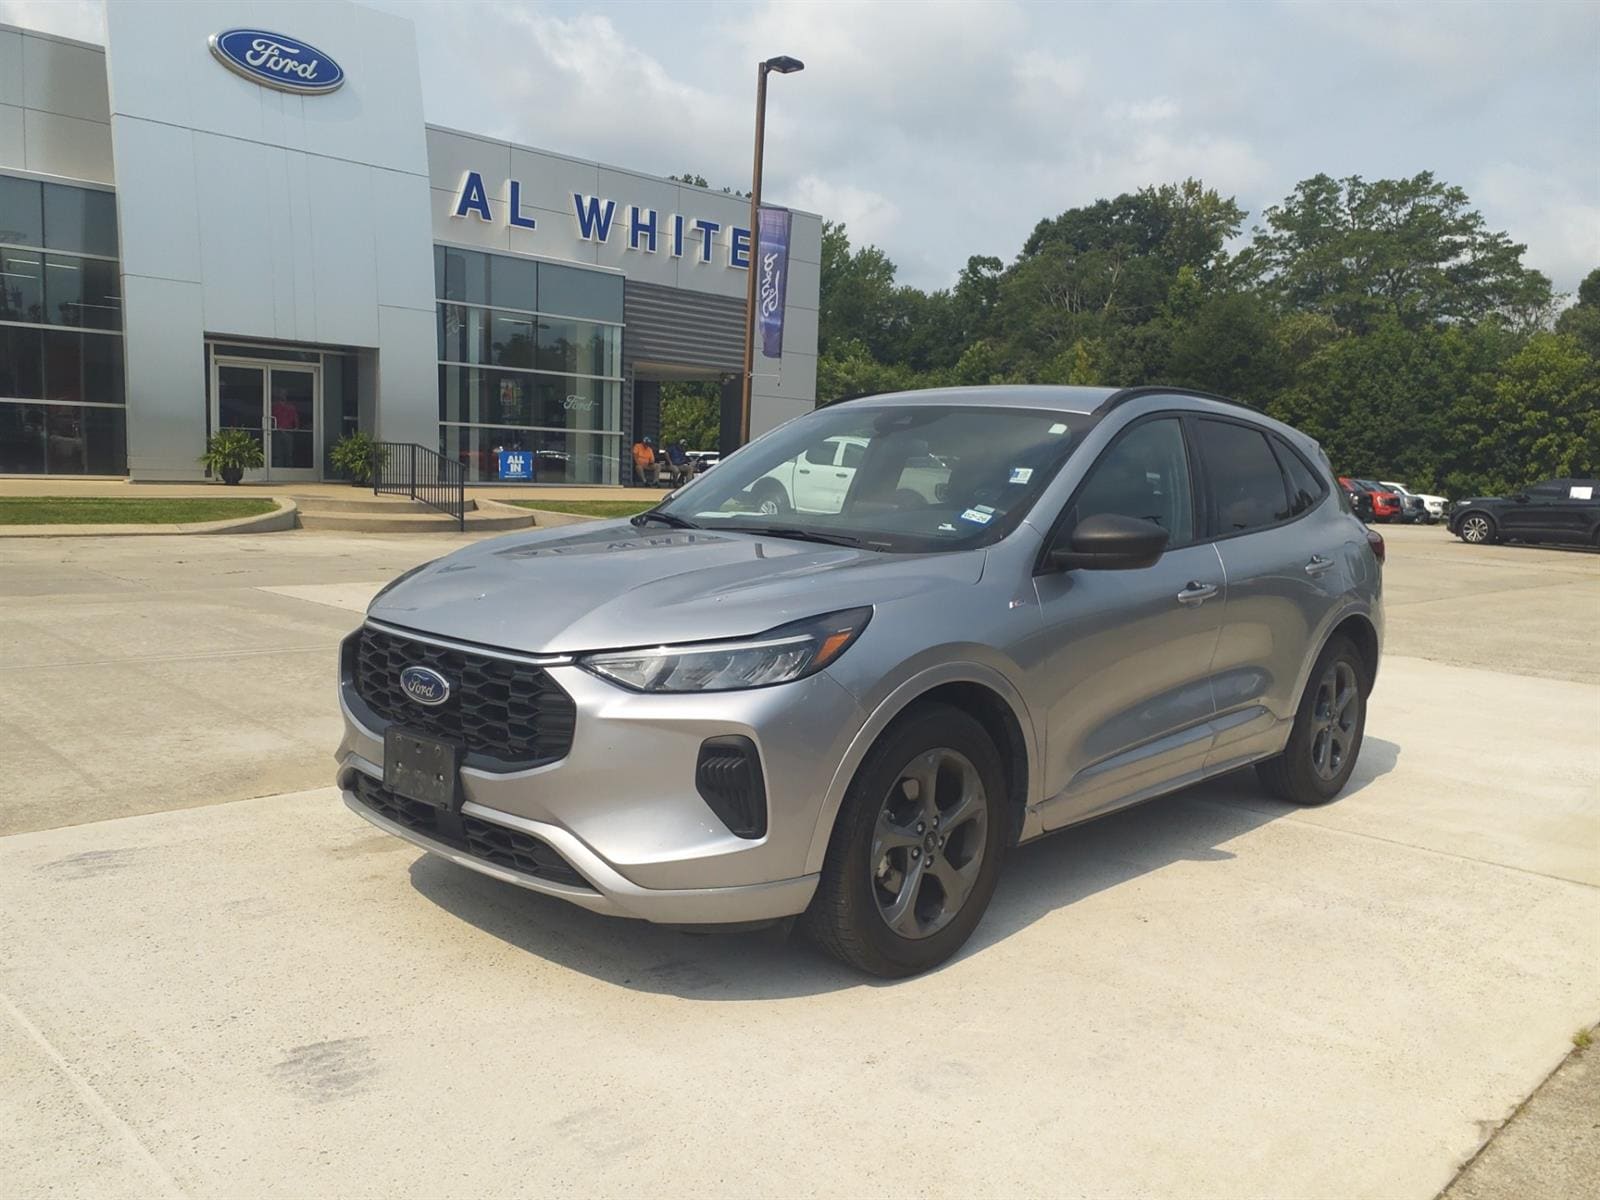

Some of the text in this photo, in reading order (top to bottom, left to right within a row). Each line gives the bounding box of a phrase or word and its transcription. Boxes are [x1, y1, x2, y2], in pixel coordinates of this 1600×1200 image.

[245, 38, 318, 80] Ford
[453, 169, 751, 269] AL WHITE
[563, 394, 593, 412] Ford
[507, 455, 525, 465] ALL
[510, 463, 522, 473] IN
[408, 673, 435, 697] Ford
